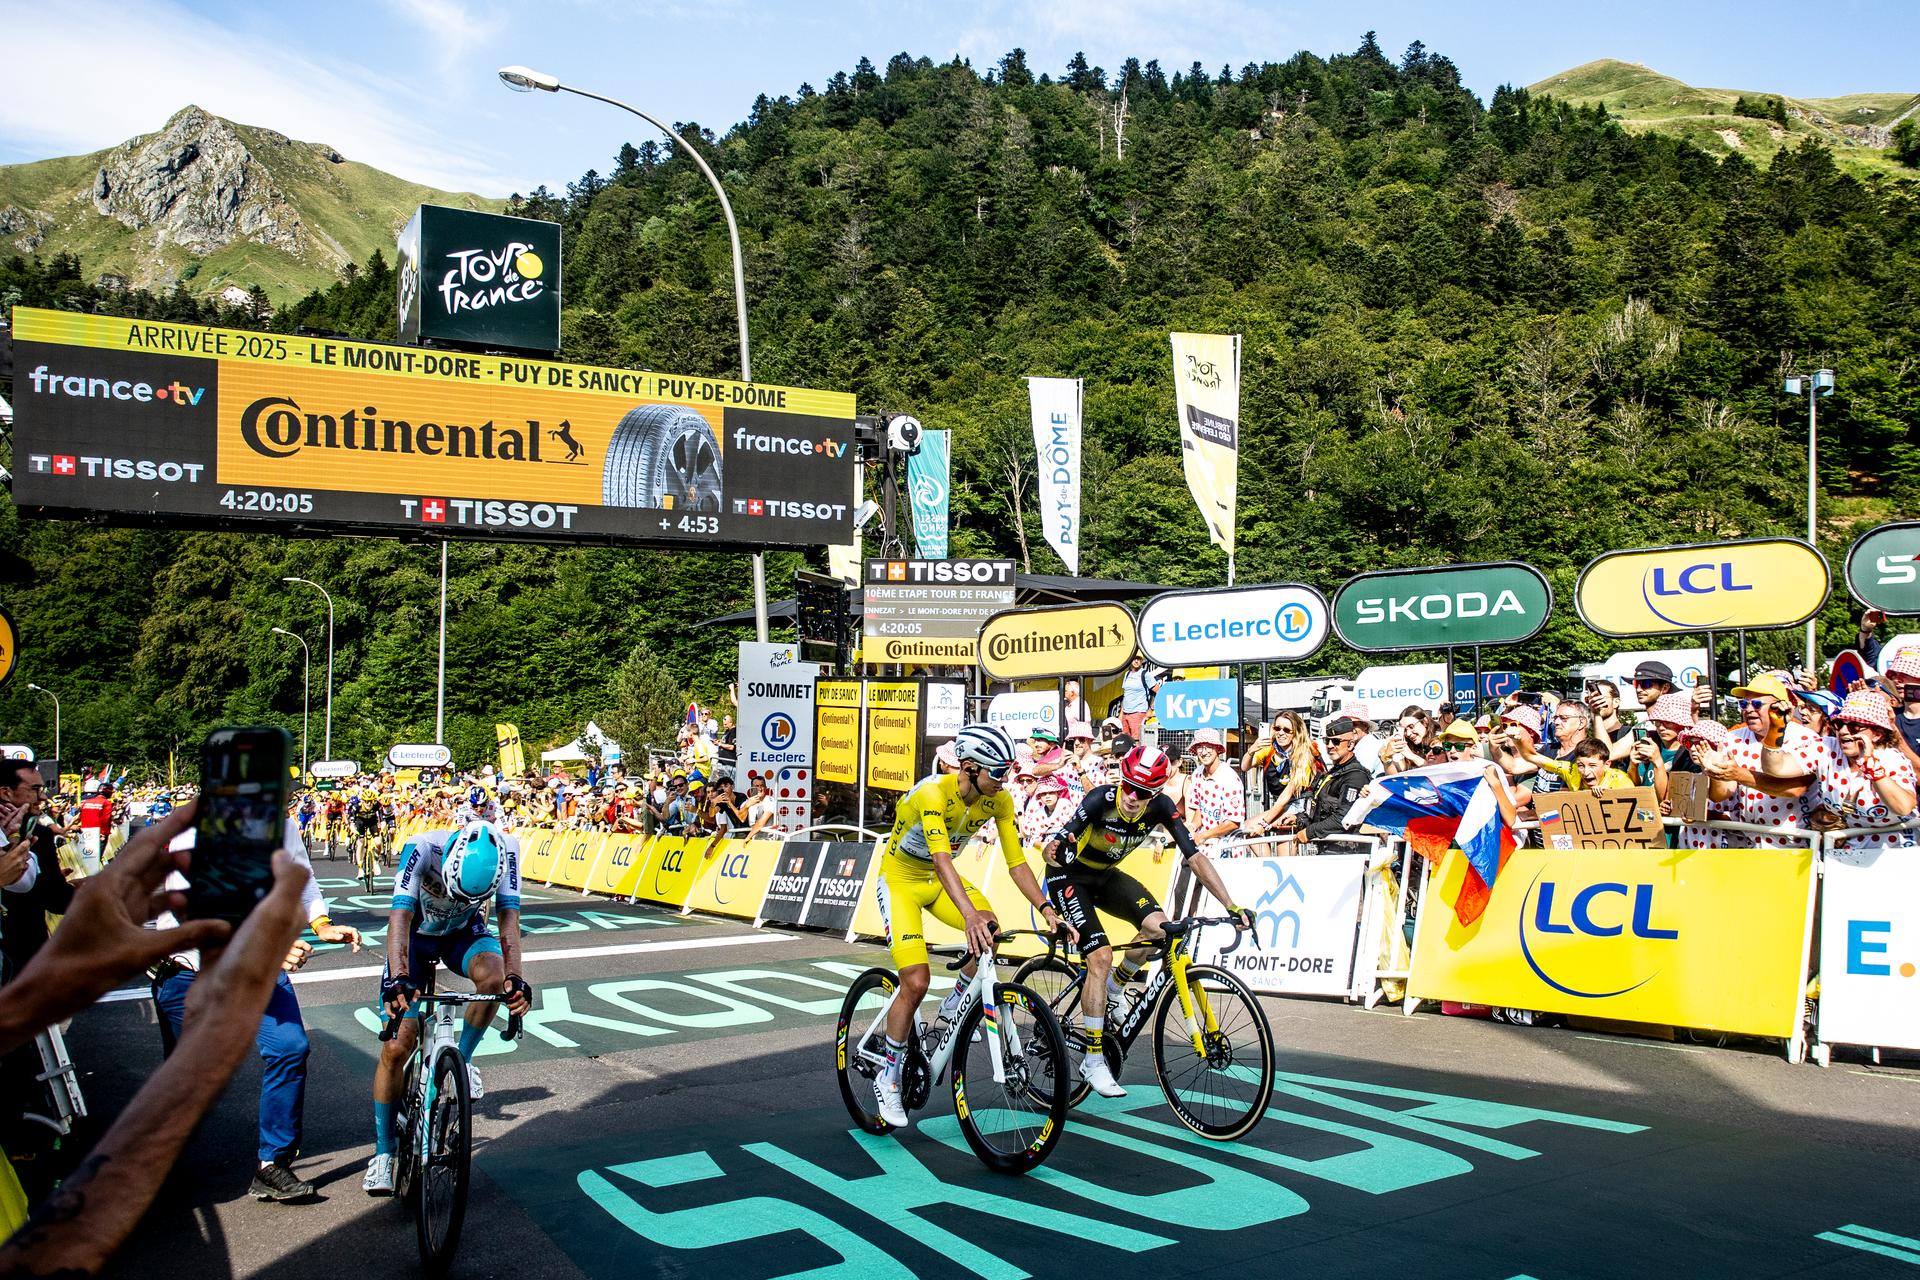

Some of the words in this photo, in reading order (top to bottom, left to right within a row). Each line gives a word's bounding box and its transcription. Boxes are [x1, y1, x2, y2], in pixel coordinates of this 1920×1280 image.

[127, 324, 228, 355] ARRIVÉE
[236, 335, 287, 360] 2025
[311, 343, 337, 366] LE
[344, 347, 480, 379] MONT-DORE
[500, 362, 542, 384] PUY
[548, 367, 573, 387] DE
[579, 370, 642, 394] SANCY
[658, 378, 786, 408] PUY-DE-DÔME
[240, 396, 543, 462] Continental
[80, 456, 204, 483] TISSOT
[219, 490, 313, 514] 4:20:05
[765, 500, 846, 521] TISSOT
[450, 499, 578, 529] TISSOT
[677, 515, 719, 534] 4:53
[909, 561, 1011, 582] TISSOT
[1653, 562, 1753, 596] LCL
[865, 586, 897, 599] 10ÈME
[899, 589, 928, 599] ETAPE
[931, 589, 957, 599] TOUR
[960, 590, 973, 599] DE
[975, 590, 1015, 599] FRANCE
[864, 607, 896, 615] ENNEZAT
[963, 608, 978, 616] PUY
[879, 622, 922, 634] 4:20:05
[1152, 616, 1271, 643] E.Leclerc
[886, 640, 974, 660] Continental
[989, 626, 1106, 661] Continental
[747, 682, 812, 699] SOMMET
[819, 688, 830, 700] PUY
[831, 688, 838, 700] DE
[838, 688, 857, 701] SANCY
[868, 689, 877, 702] LE
[877, 689, 915, 702] MONT-DORE
[1165, 693, 1232, 723] Krys
[821, 712, 850, 727] Continental
[874, 714, 906, 729] Continental
[820, 736, 849, 751] Continental
[873, 741, 905, 755] Continental
[750, 752, 806, 763] E.Leclerc
[820, 760, 849, 775] Continental
[872, 766, 905, 781] Continental
[1561, 797, 1643, 836] ALLEZ
[926, 828, 945, 836] LCL
[537, 840, 551, 856] LCL
[570, 843, 587, 860] LCL
[612, 846, 632, 867] LCL
[401, 849, 421, 890] MERIDA
[662, 850, 684, 872] LCL
[721, 854, 749, 878] LCL
[506, 852, 518, 891] MERIDA
[771, 876, 810, 894] TISSOT
[818, 878, 863, 898] TISSOT
[1067, 896, 1087, 928] VISMA
[1535, 882, 1679, 940] LCL
[1212, 955, 1229, 969] LE
[1234, 955, 1334, 974] MONT-DORE
[1251, 976, 1285, 987] SANCY
[939, 993, 972, 1051] COLNAGO
